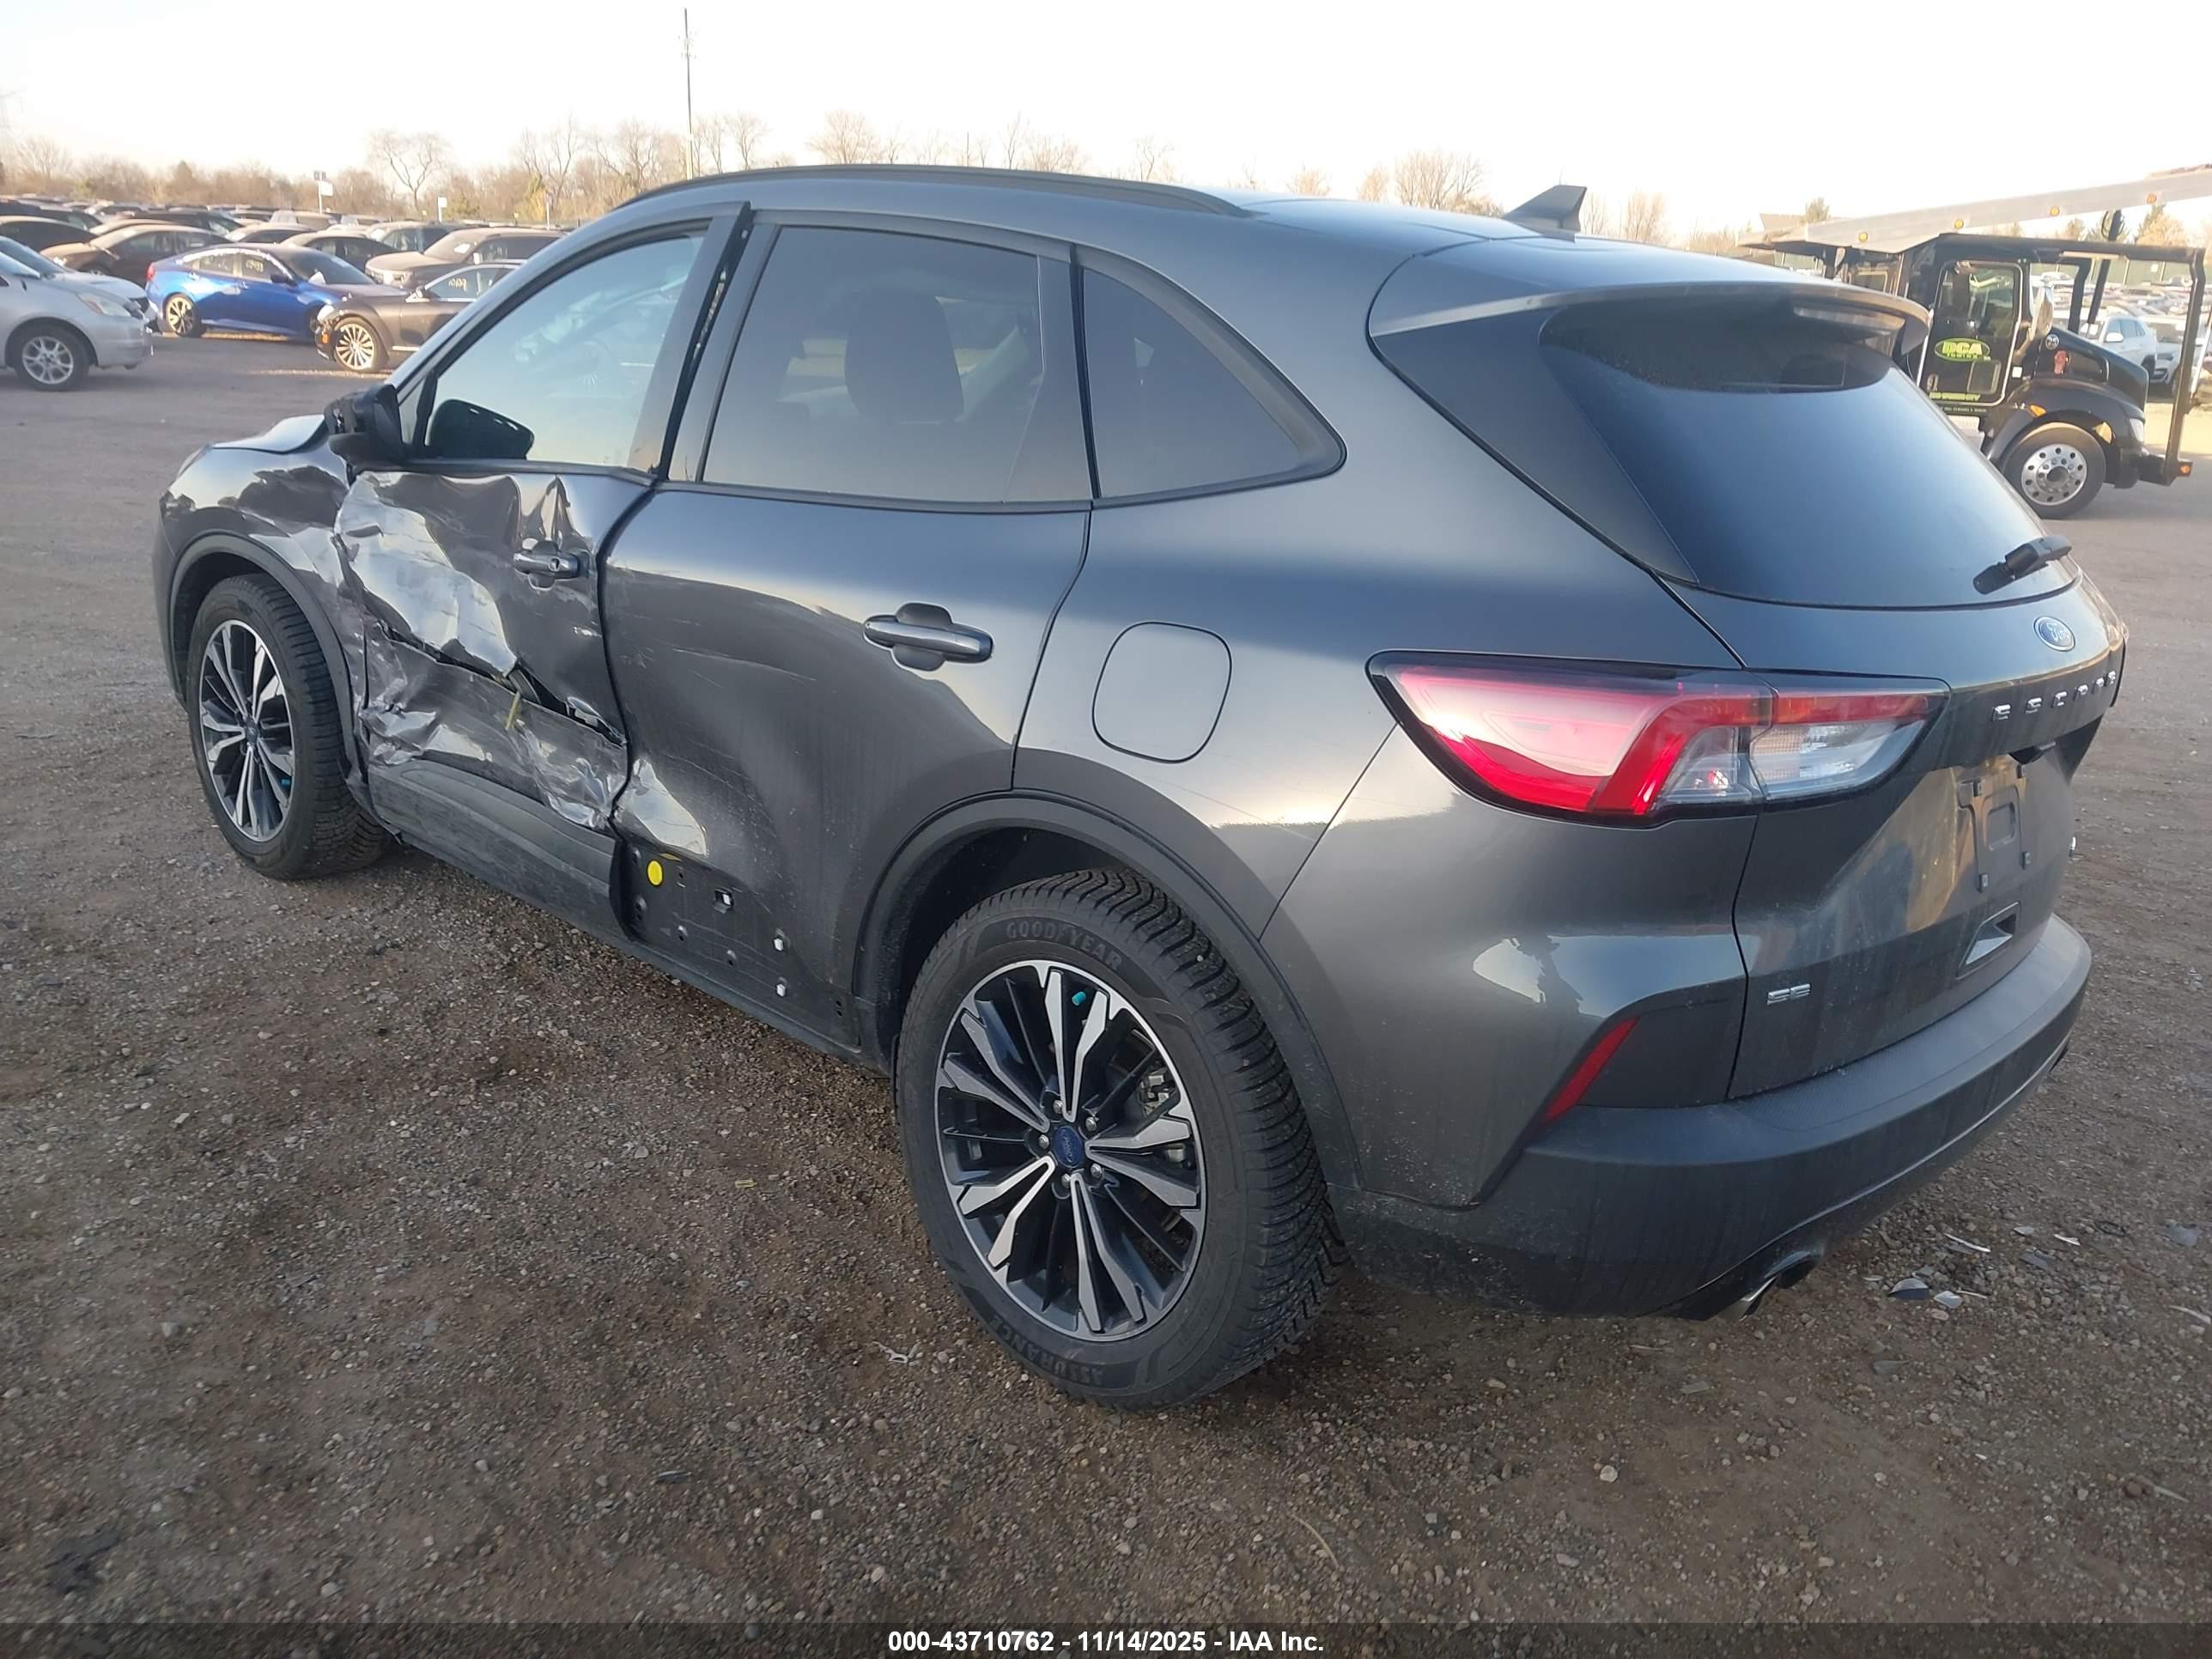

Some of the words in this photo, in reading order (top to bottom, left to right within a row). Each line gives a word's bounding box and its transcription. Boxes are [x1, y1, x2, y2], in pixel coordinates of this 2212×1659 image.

[1942, 341, 1983, 356] DCA
[2045, 622, 2071, 642] Ford
[1991, 671, 2117, 721] ESCAPE
[1006, 921, 1122, 970] GOODYEAR
[1767, 983, 1811, 1006] SE
